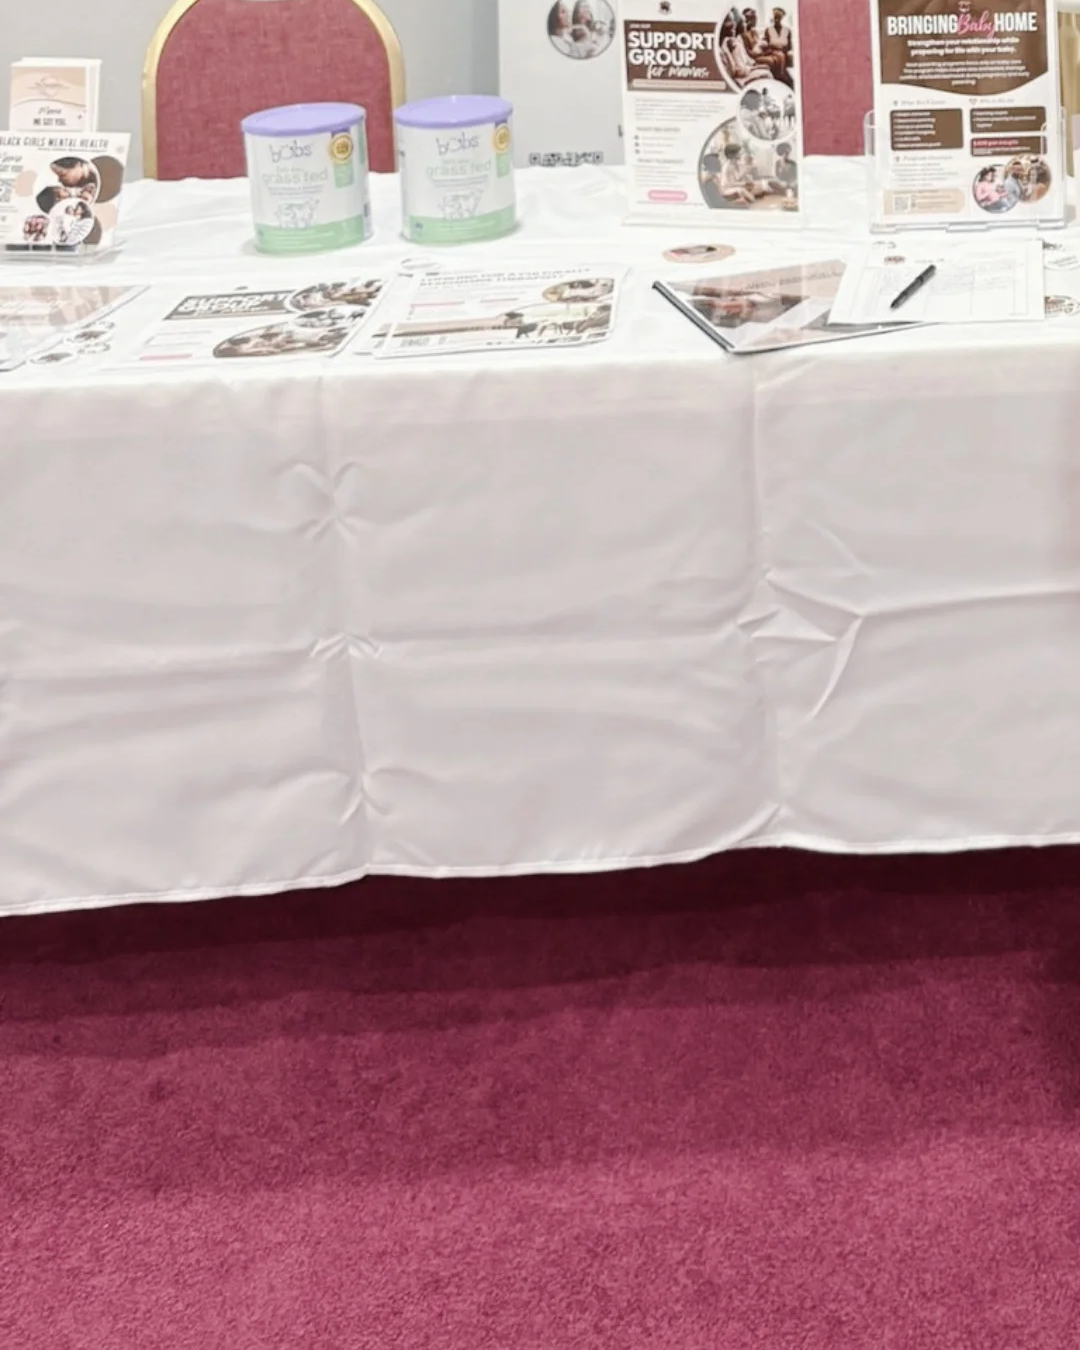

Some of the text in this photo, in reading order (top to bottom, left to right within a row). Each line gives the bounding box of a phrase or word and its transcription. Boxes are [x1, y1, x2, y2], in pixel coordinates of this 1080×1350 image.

[887, 9, 1038, 39] BRINGING Baby HOME
[628, 31, 715, 49] SUPPORT
[628, 49, 697, 66] GROUP
[647, 63, 665, 79] for
[24, 136, 46, 147] GIRLS
[48, 137, 77, 148] MENTAL
[80, 138, 109, 149] HEALTH
